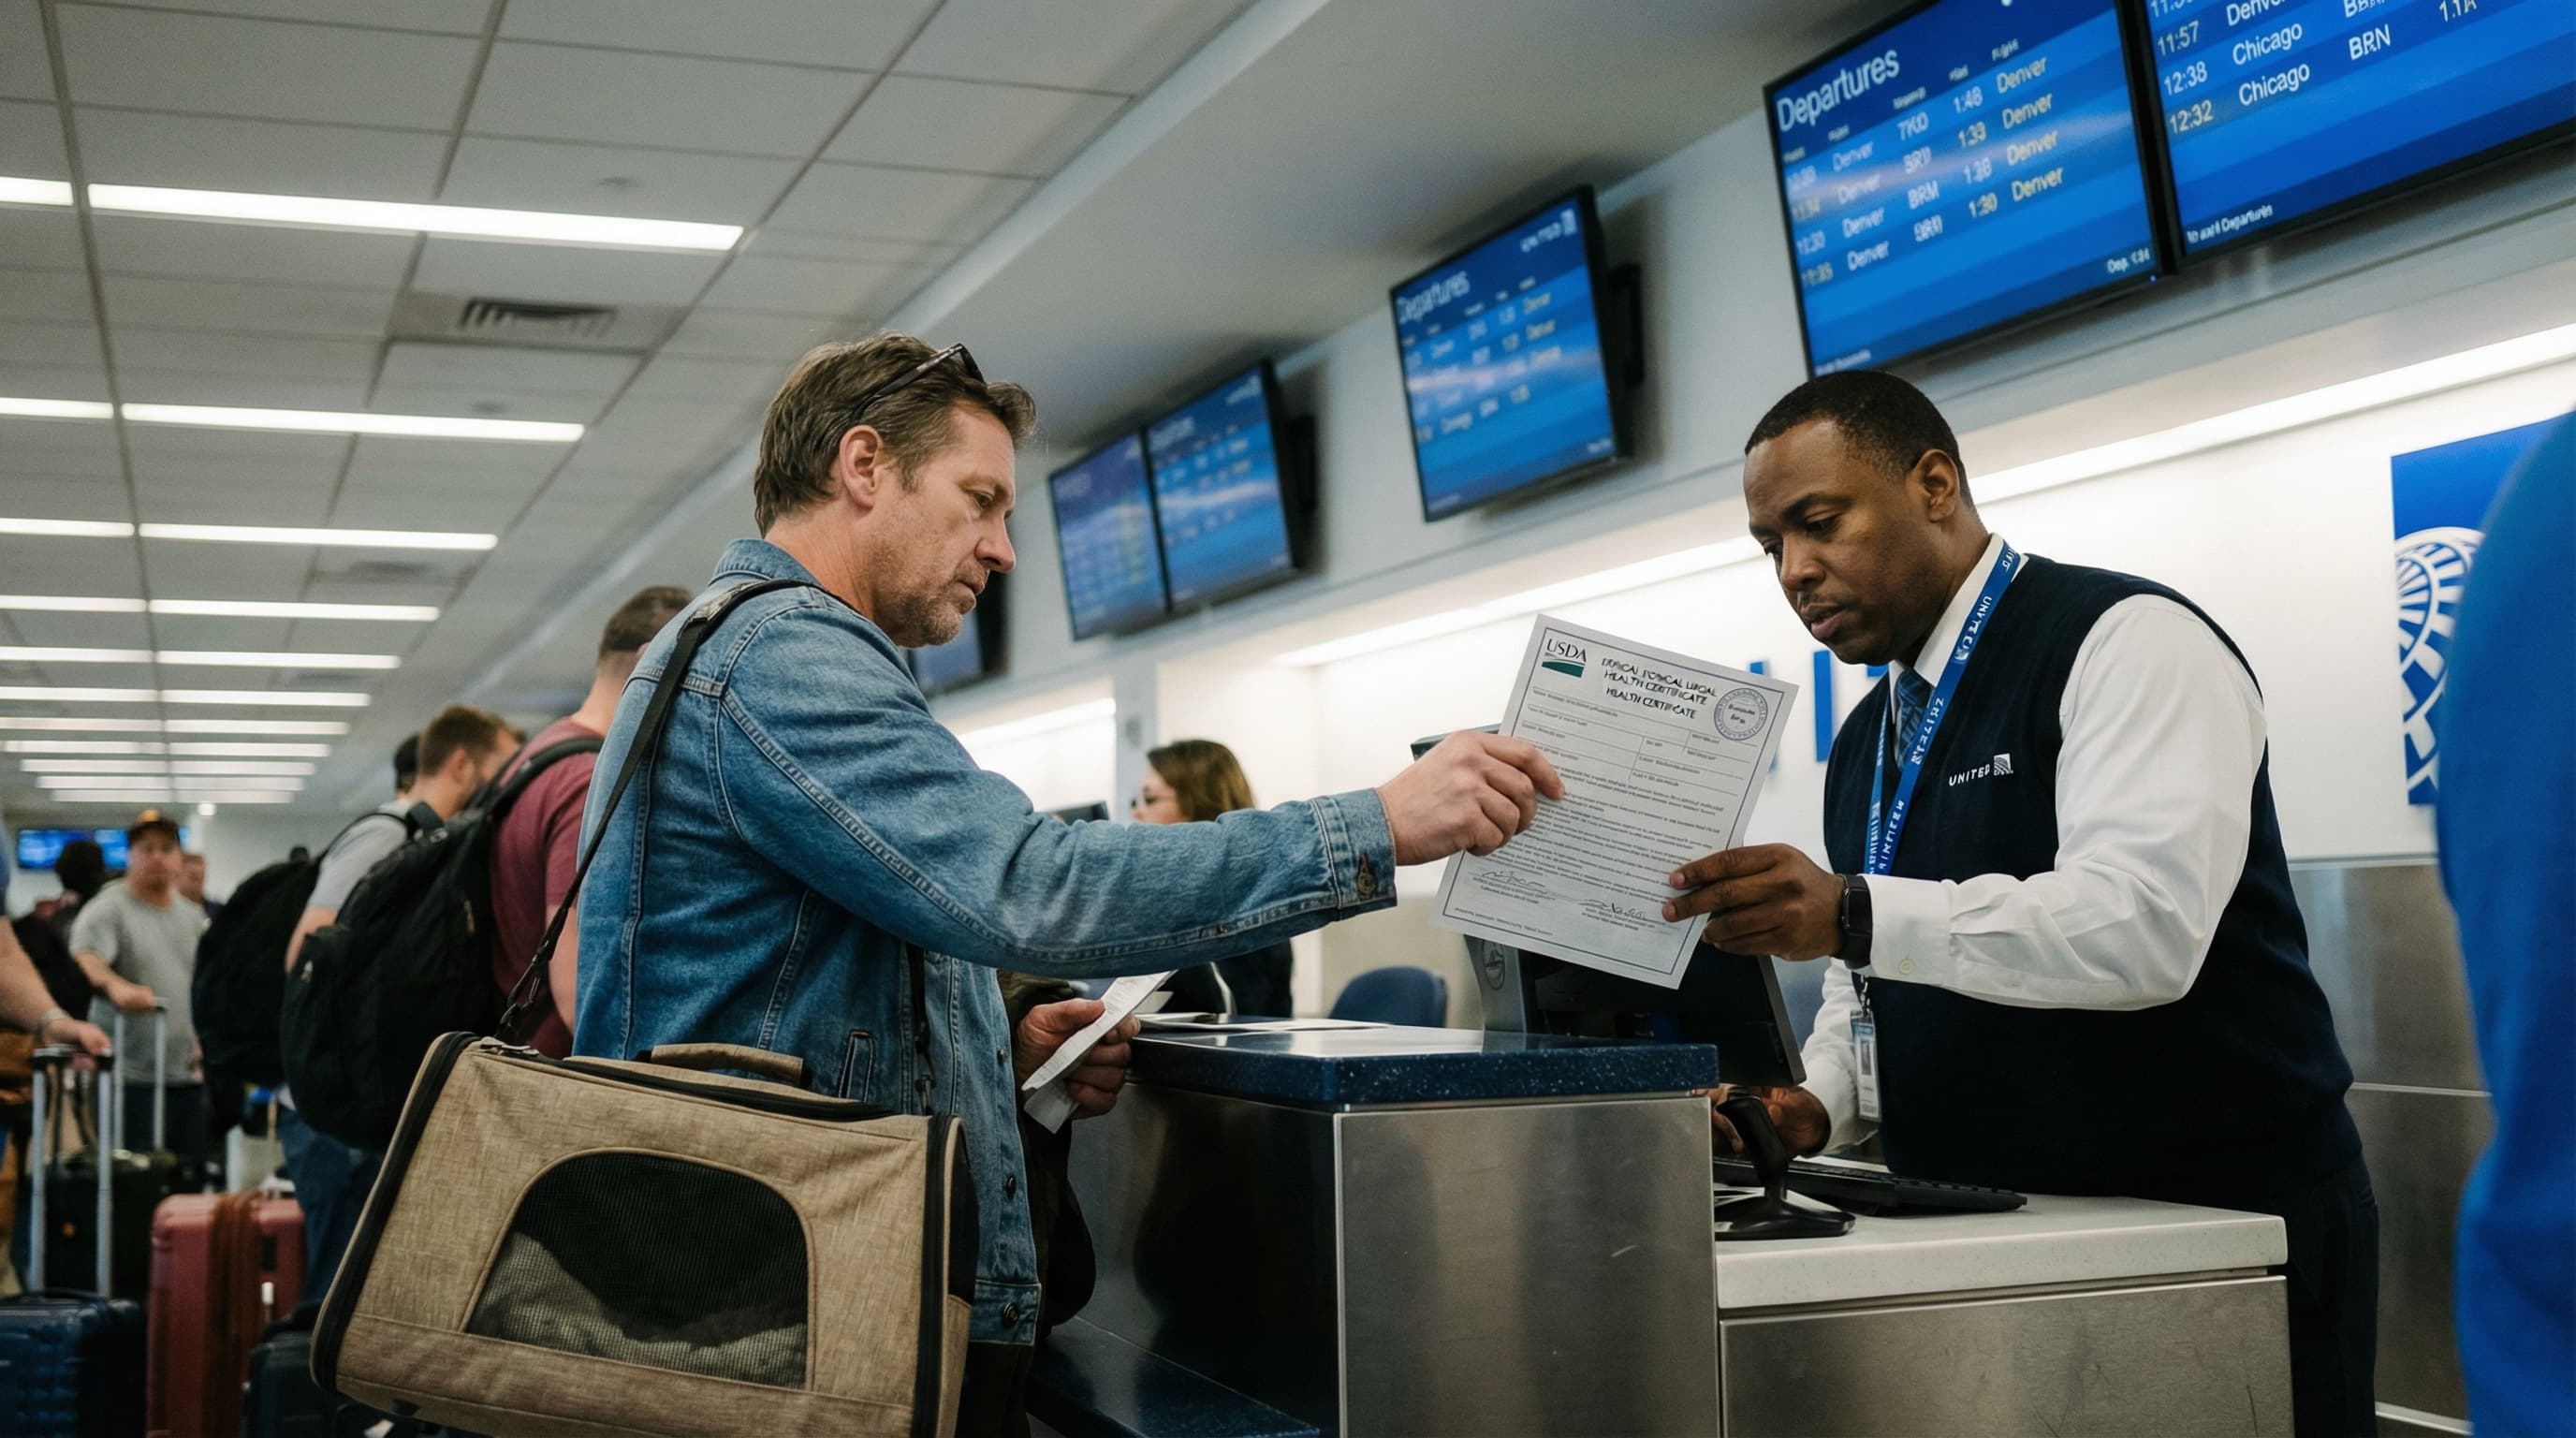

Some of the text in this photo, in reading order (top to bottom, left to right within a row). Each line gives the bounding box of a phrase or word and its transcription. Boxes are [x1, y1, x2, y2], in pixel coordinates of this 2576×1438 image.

[2158, 20, 2200, 57] 11:57
[2164, 22, 2303, 96] 12:38 Chicago
[1777, 50, 1900, 132] Departures
[1997, 57, 2047, 94] Denver
[2170, 99, 2213, 135] 12:32
[2239, 64, 2310, 106] Chicago
[2002, 94, 2053, 129] Denver
[1842, 208, 1885, 239] Denver
[2007, 130, 2058, 166] Denver
[1847, 241, 1890, 271] Denver
[2012, 168, 2064, 202] Denver
[1546, 638, 1588, 663] USDA
